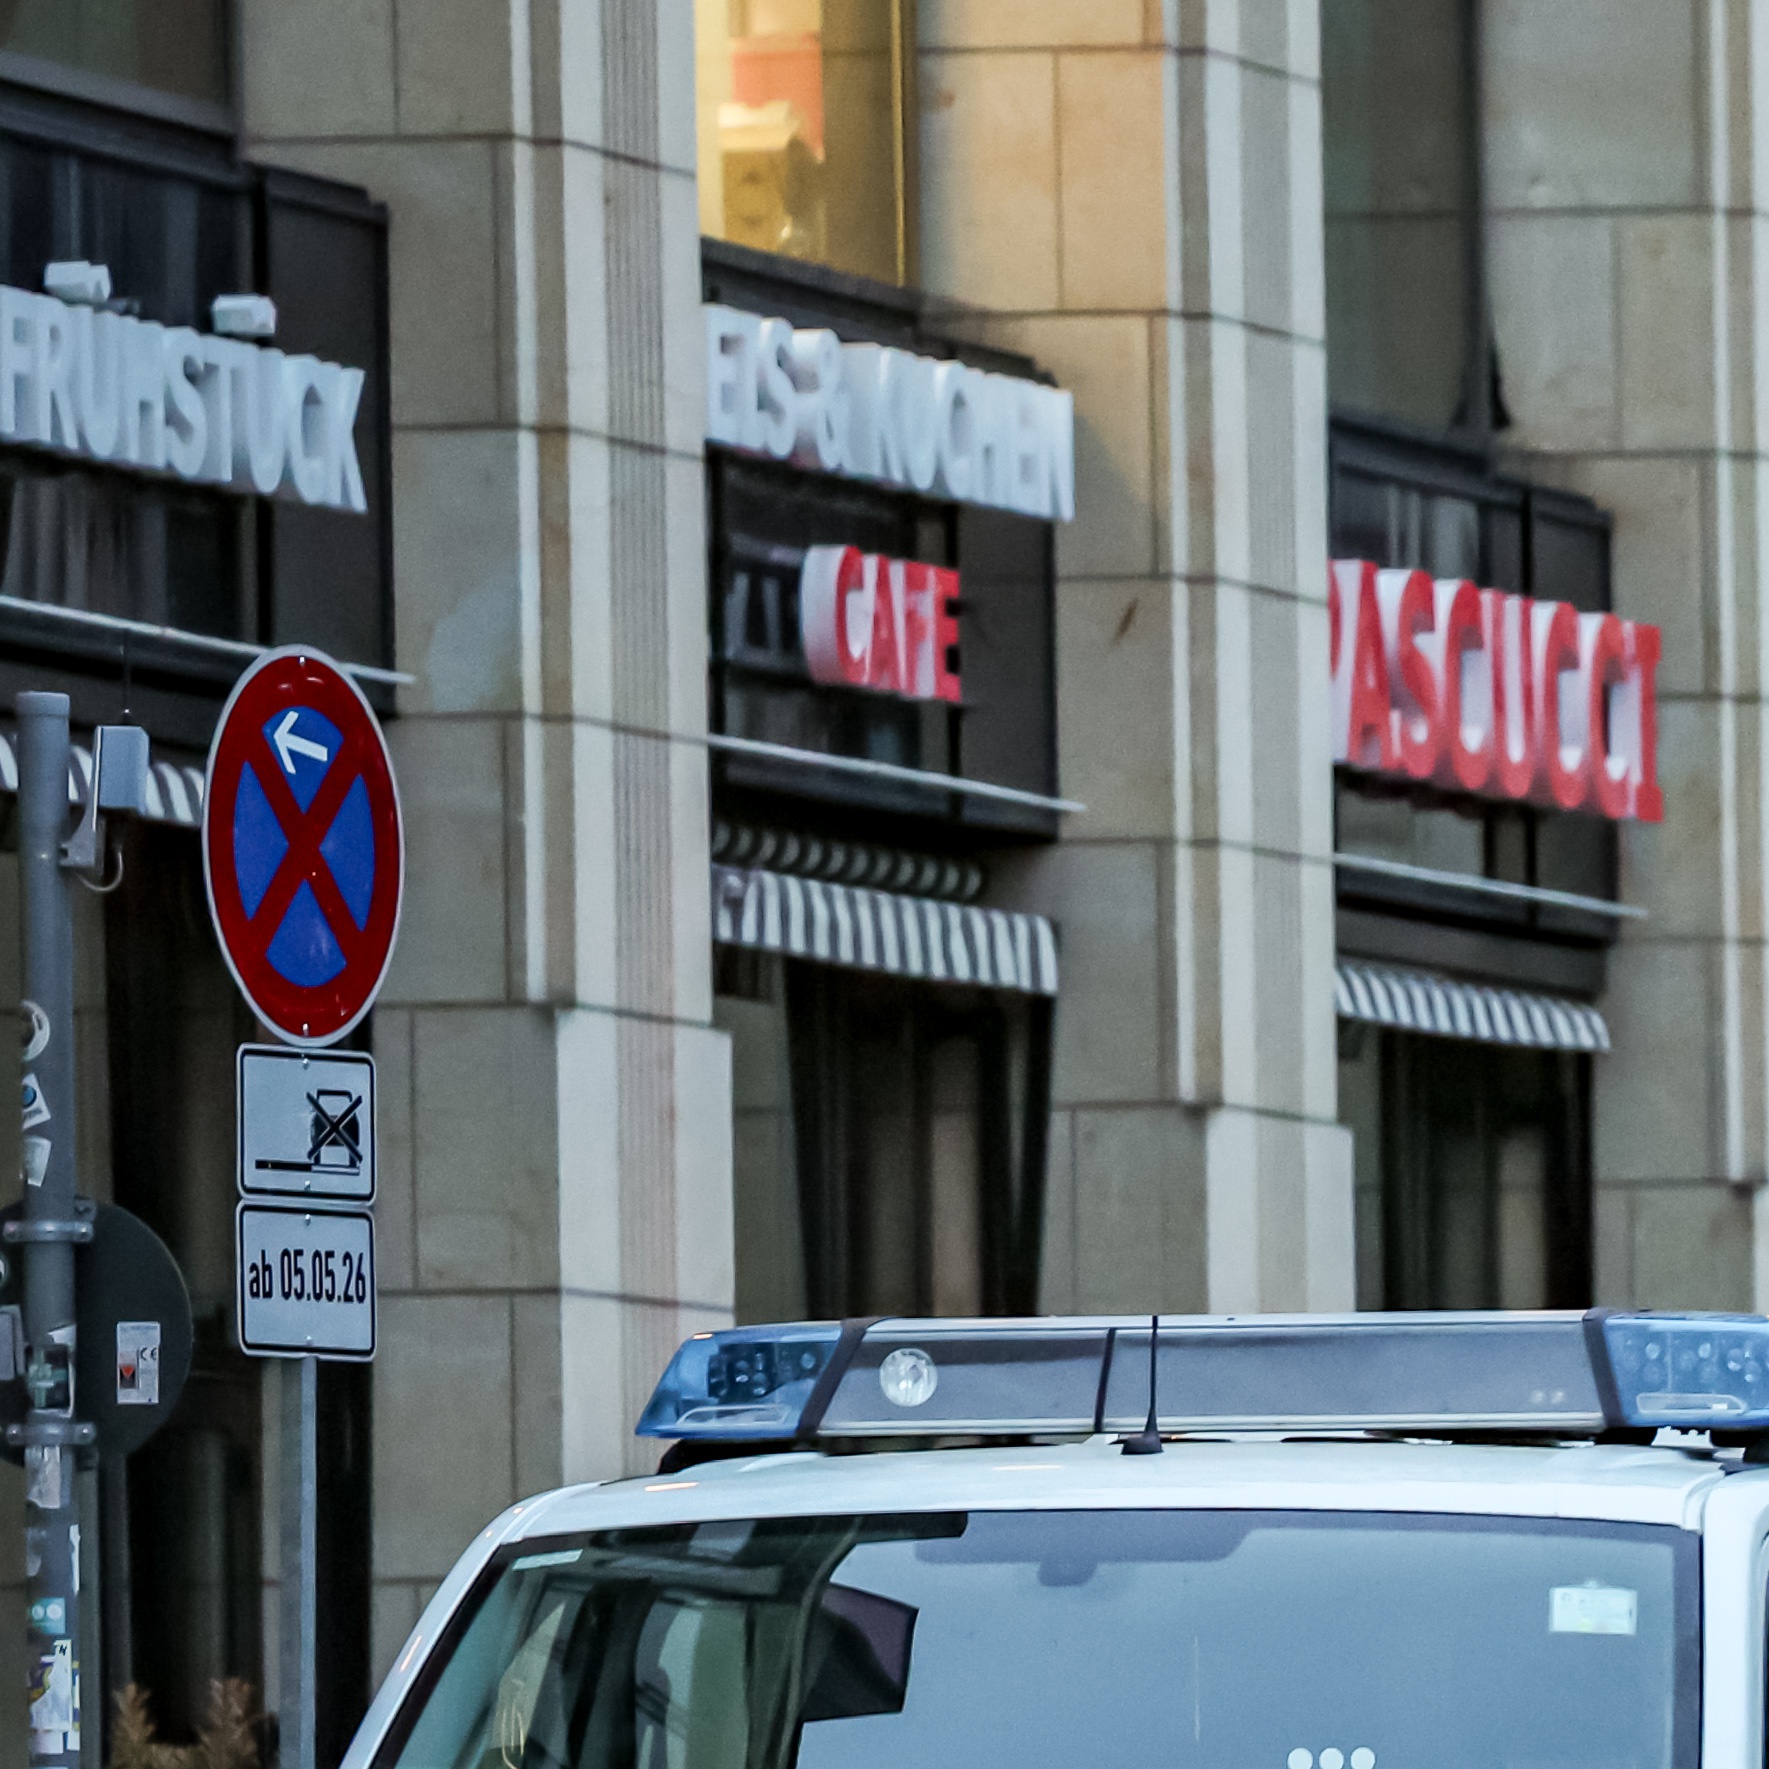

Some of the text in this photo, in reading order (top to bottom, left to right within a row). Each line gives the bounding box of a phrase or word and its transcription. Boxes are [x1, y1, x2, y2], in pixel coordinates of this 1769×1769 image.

[0, 261, 367, 513] FRÜHSTÜCK
[704, 303, 796, 459] EIS
[848, 342, 1075, 523] KUCHEN
[249, 1247, 367, 1304] ab 05.05.26
